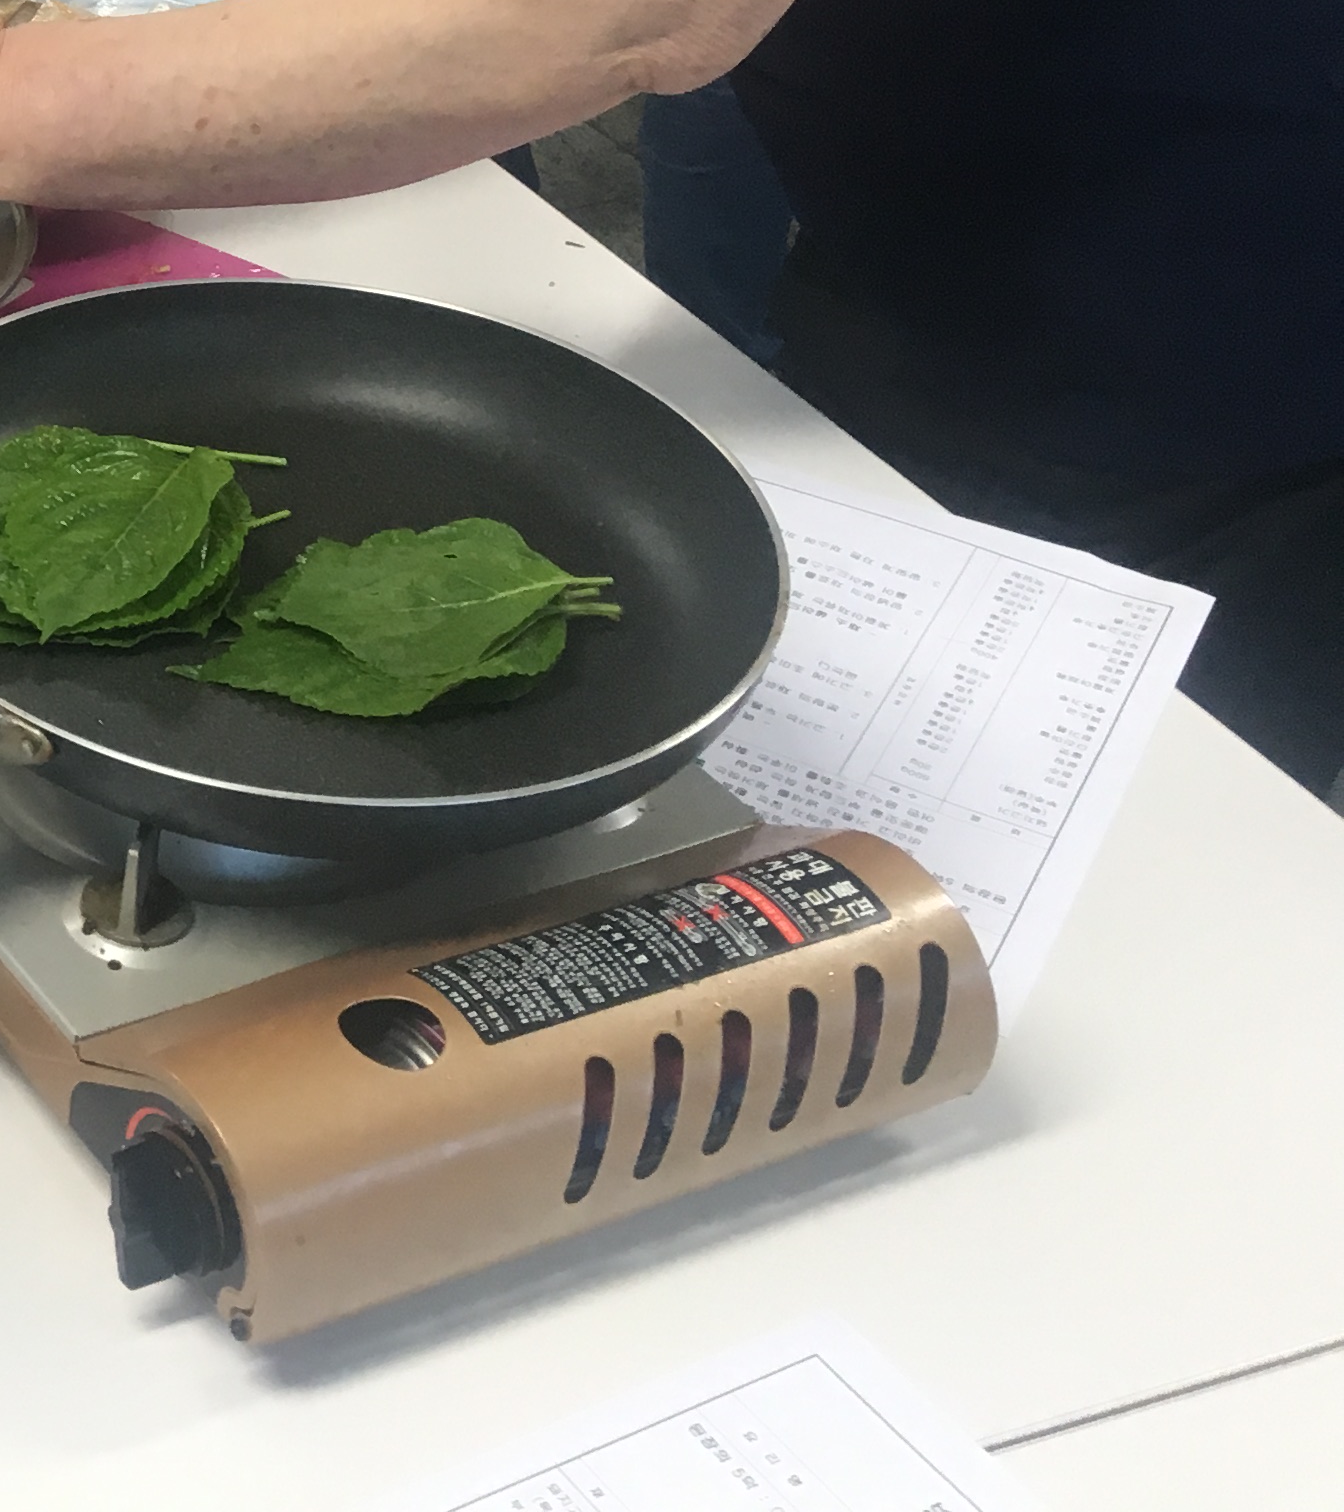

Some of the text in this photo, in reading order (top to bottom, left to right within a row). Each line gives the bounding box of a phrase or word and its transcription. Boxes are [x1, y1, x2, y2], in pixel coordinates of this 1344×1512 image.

[765, 860, 806, 882] 사용
[803, 887, 853, 927] 금지
[787, 851, 834, 876] 과대
[828, 880, 878, 919] 불판
